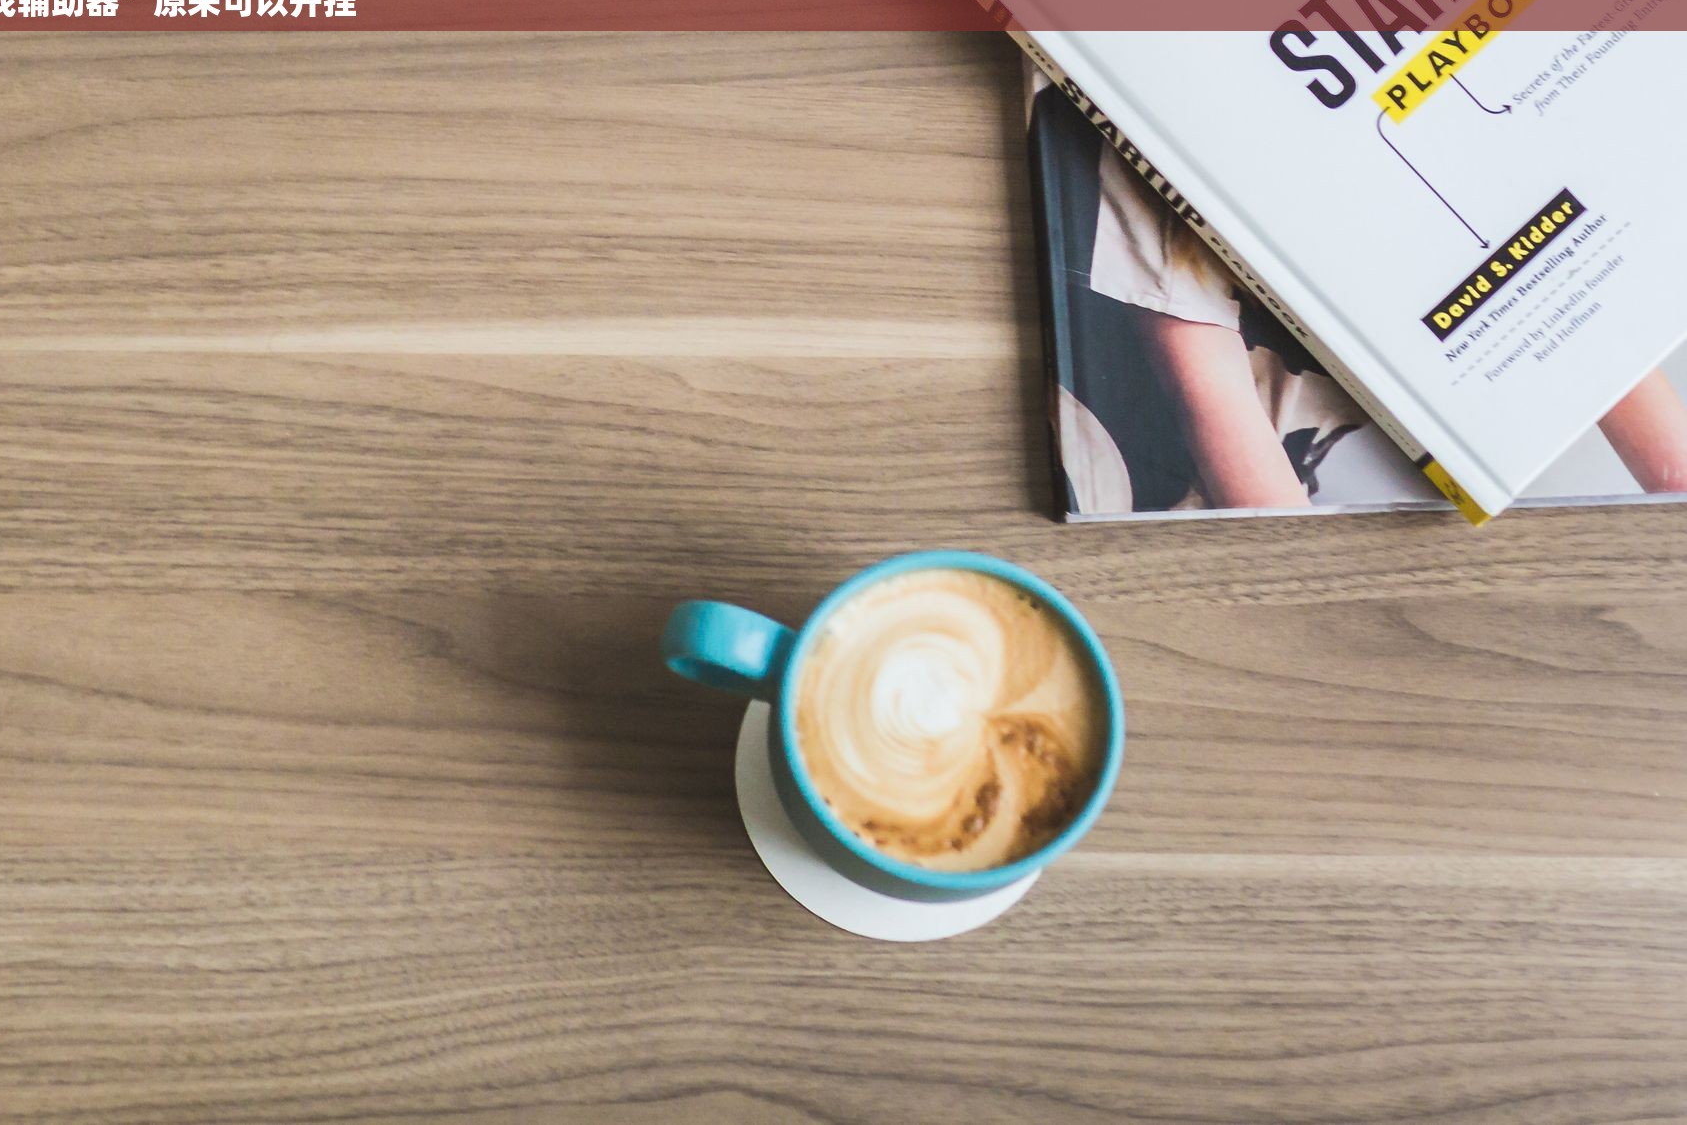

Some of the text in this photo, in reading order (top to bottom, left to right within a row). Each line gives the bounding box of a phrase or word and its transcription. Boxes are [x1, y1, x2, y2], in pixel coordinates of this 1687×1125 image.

[1060, 76, 1208, 229] STARTUP
[1209, 236, 1308, 338] PLAYBOOK
[1432, 201, 1573, 330] David S. Kidder
[1444, 214, 1607, 363] New York Times Bestselling Author
